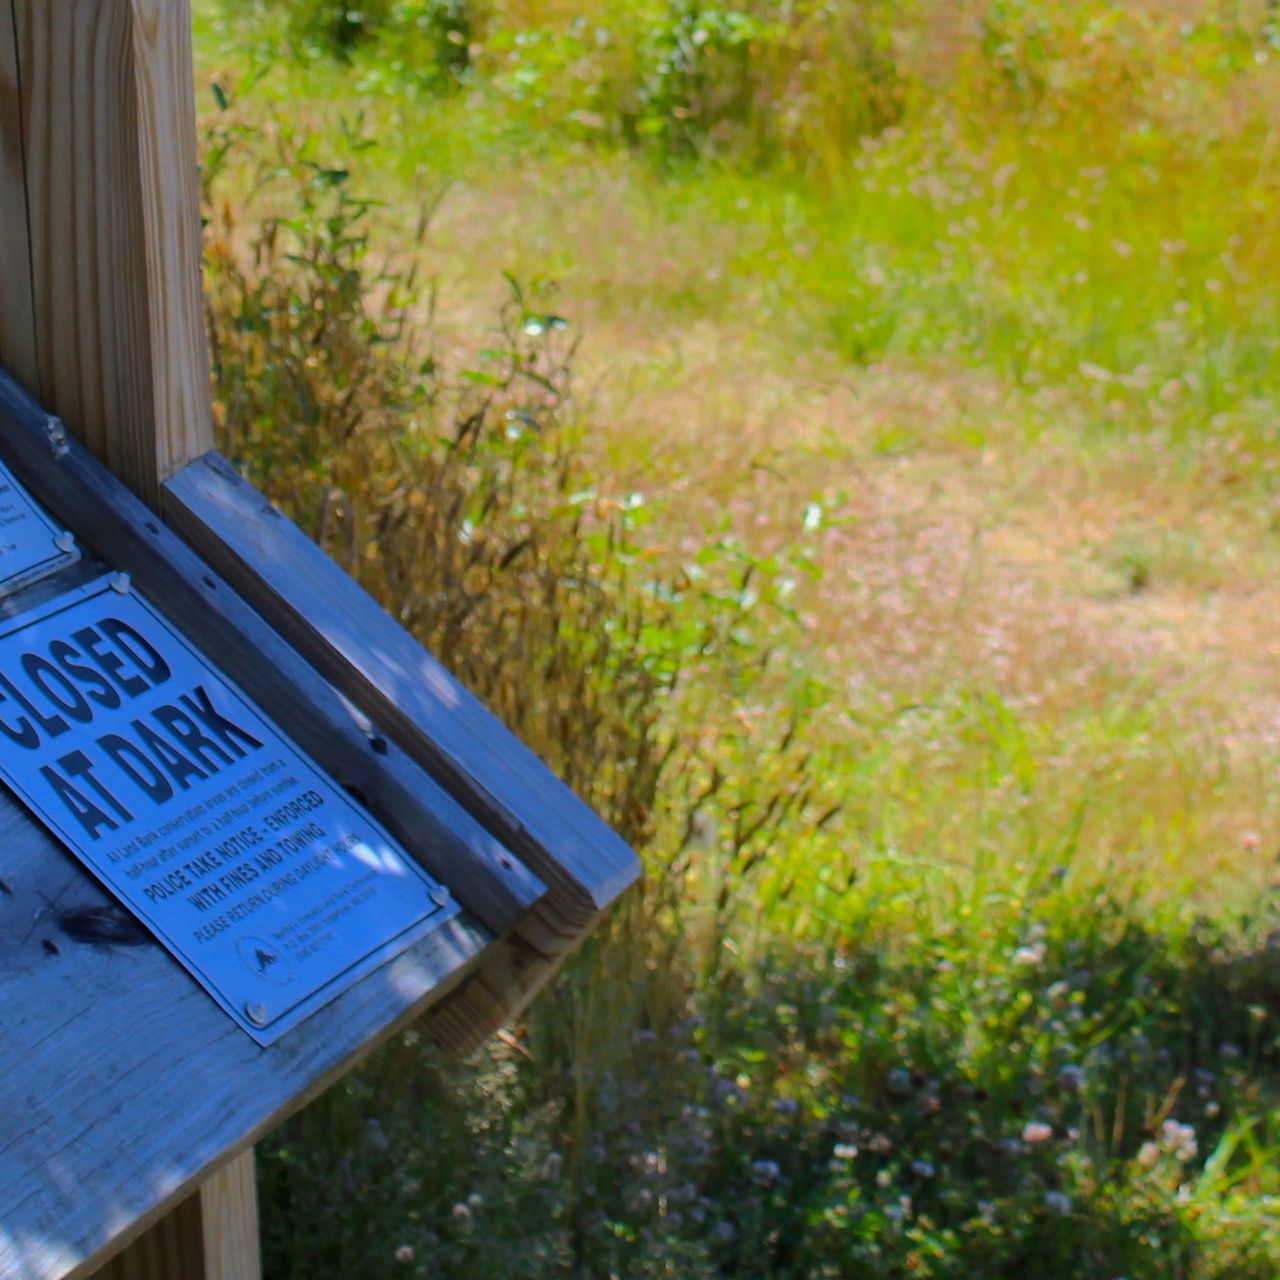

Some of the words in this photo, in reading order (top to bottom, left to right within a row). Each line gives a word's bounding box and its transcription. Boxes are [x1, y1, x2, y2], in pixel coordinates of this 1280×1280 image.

[38, 750, 134, 840] AT
[97, 685, 265, 803] DARK
[116, 840, 141, 858] Land
[134, 831, 159, 848] Bank
[158, 804, 208, 836] conservation
[203, 793, 228, 810] areas
[224, 786, 241, 798] are
[237, 770, 264, 790] closed
[143, 870, 192, 904] POLICE
[183, 852, 223, 879] TAKE
[215, 827, 264, 861] NOTICE
[264, 791, 324, 831] ENFORCED
[157, 846, 178, 862] after
[176, 830, 206, 852] sunset
[200, 825, 214, 836] to
[187, 884, 227, 912] WITH
[218, 863, 260, 893] FINES
[253, 849, 283, 872] AND
[275, 823, 326, 856] TOWING
[193, 915, 231, 944] PLEASE
[226, 895, 265, 923] RETURN
[261, 873, 299, 902] DURING
[293, 849, 340, 880] DAYLIGHT
